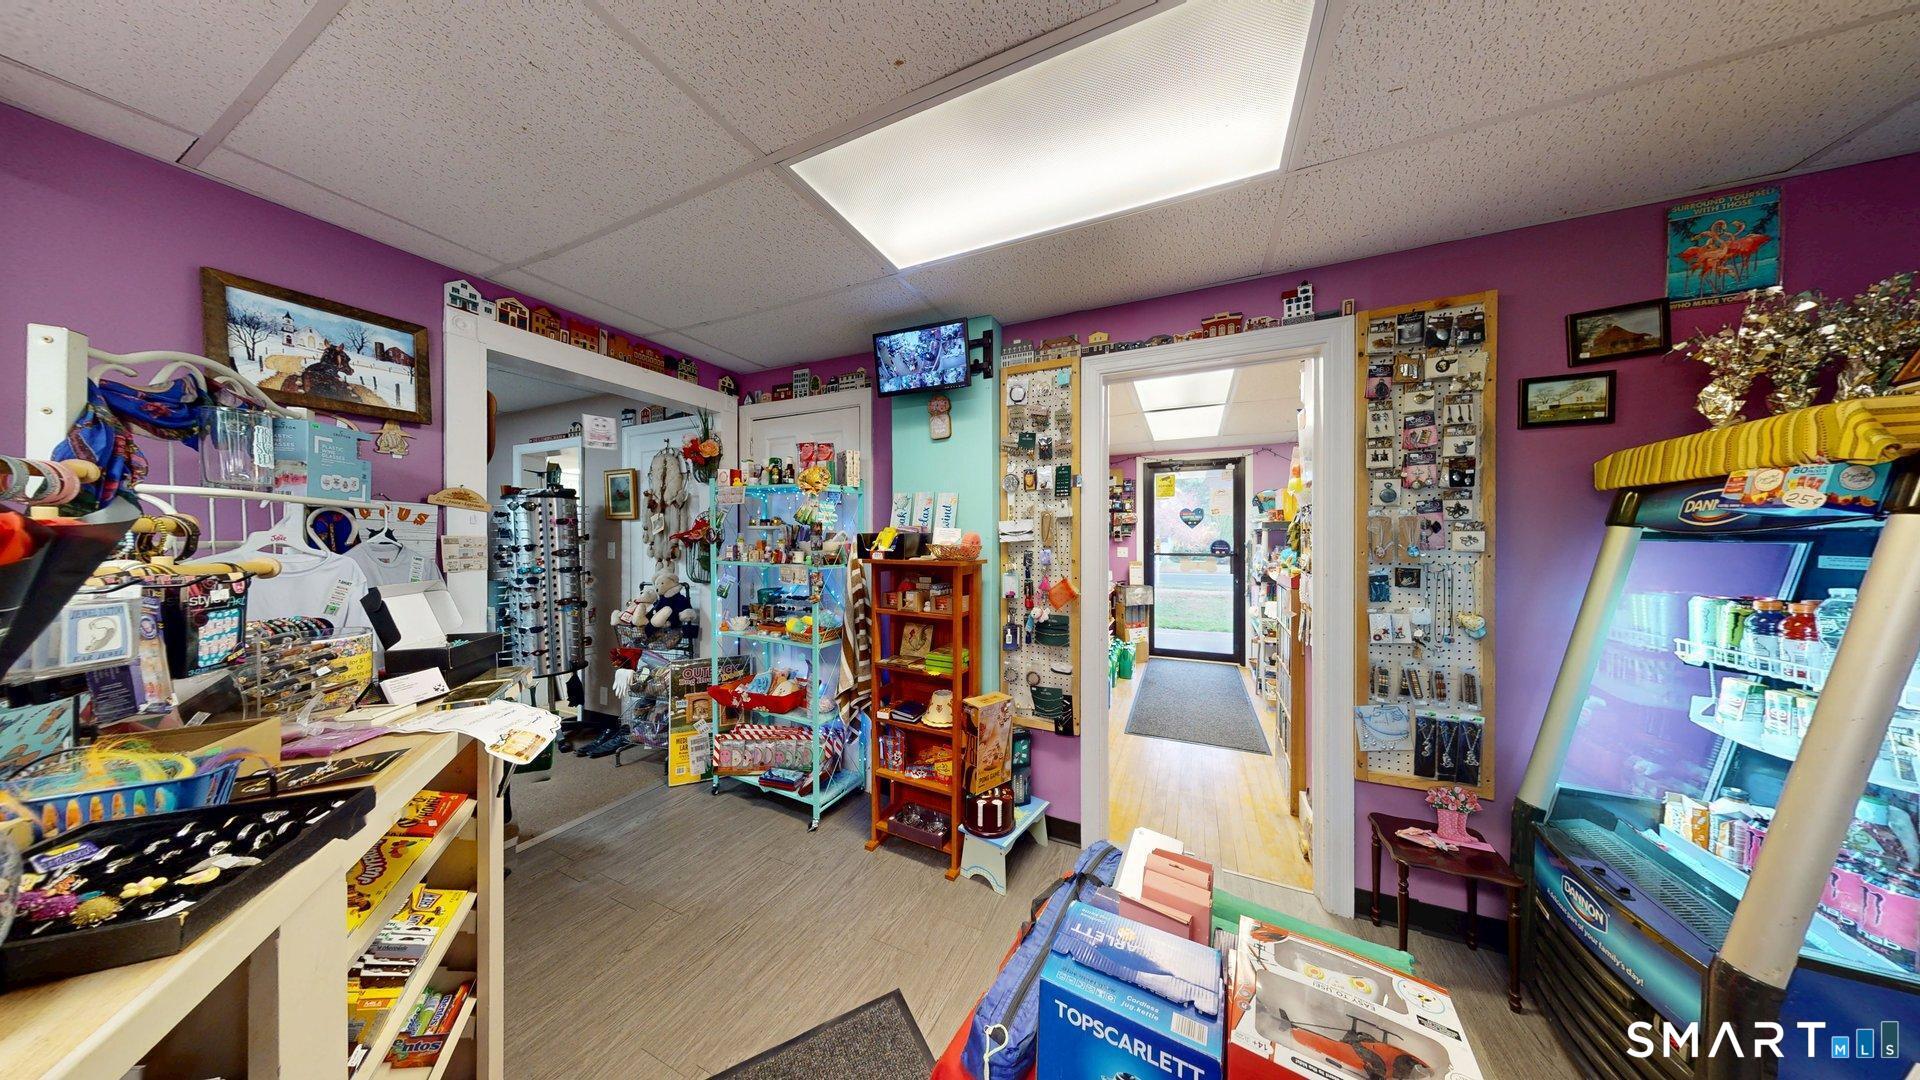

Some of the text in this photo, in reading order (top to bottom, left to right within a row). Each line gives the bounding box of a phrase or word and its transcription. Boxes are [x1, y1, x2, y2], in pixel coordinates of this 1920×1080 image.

[1671, 198, 1726, 213] SURROUND
[1694, 199, 1752, 215] WITH THOSE
[1670, 301, 1691, 310] WHO
[1693, 298, 1719, 307] MAKE
[1793, 466, 1808, 475] 60
[941, 504, 952, 528] wind
[1564, 880, 1604, 925] DANNON
[1584, 929, 1599, 946] your
[1598, 942, 1626, 971] family's
[1625, 965, 1645, 987] day!
[1335, 991, 1350, 1001] TO
[1126, 995, 1160, 1014] Cordless
[1352, 997, 1377, 1012] EASY
[394, 1037, 442, 1054] entos
[1054, 998, 1206, 1080] TOPSCARLETT
[1252, 1041, 1268, 1051] 14+
